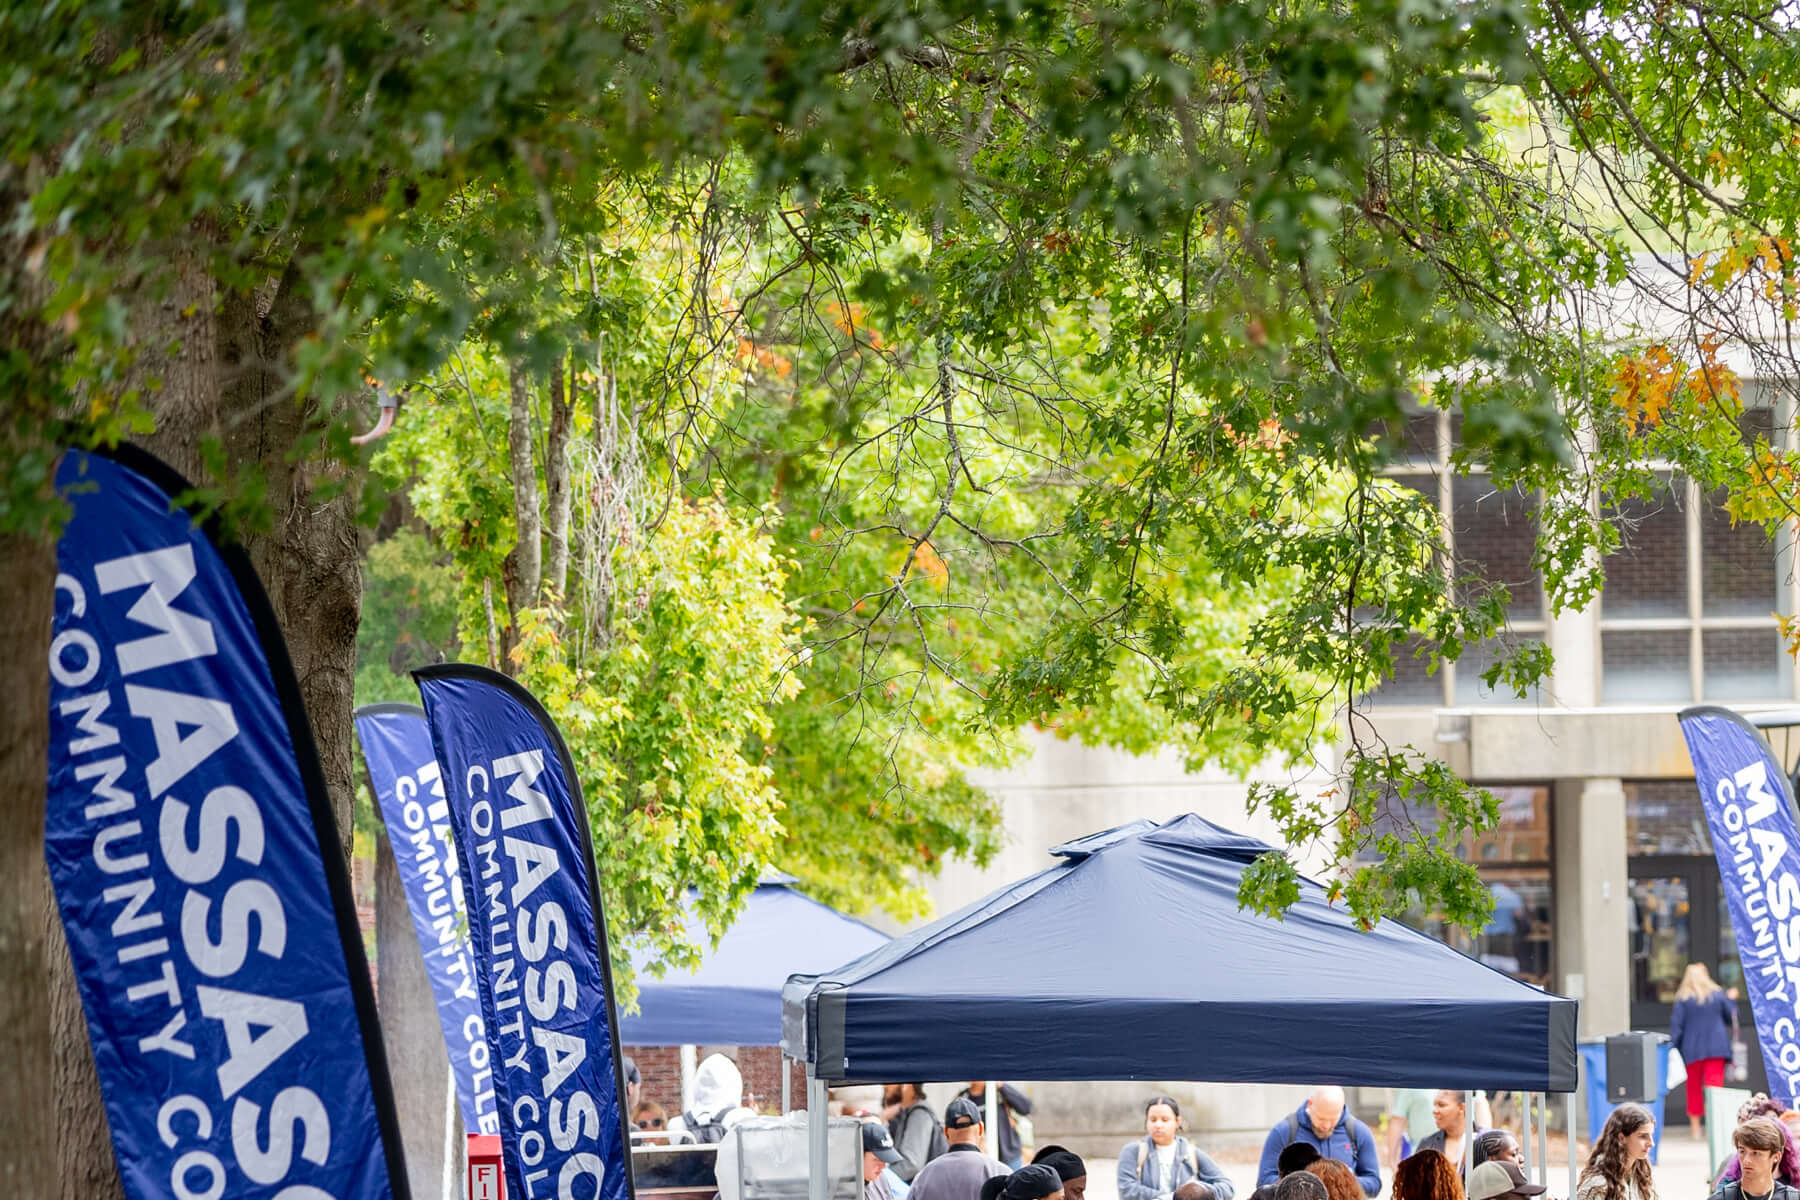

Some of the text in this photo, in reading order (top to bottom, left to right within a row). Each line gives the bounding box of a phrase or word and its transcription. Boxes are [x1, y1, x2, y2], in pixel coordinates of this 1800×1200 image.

[48, 574, 196, 1061] COMMUNITY
[395, 775, 477, 1000] COMMUNITY
[466, 765, 532, 1073] COMMUNITY
[1715, 777, 1789, 1003] COMMUNITY
[463, 1014, 500, 1136] COLLE
